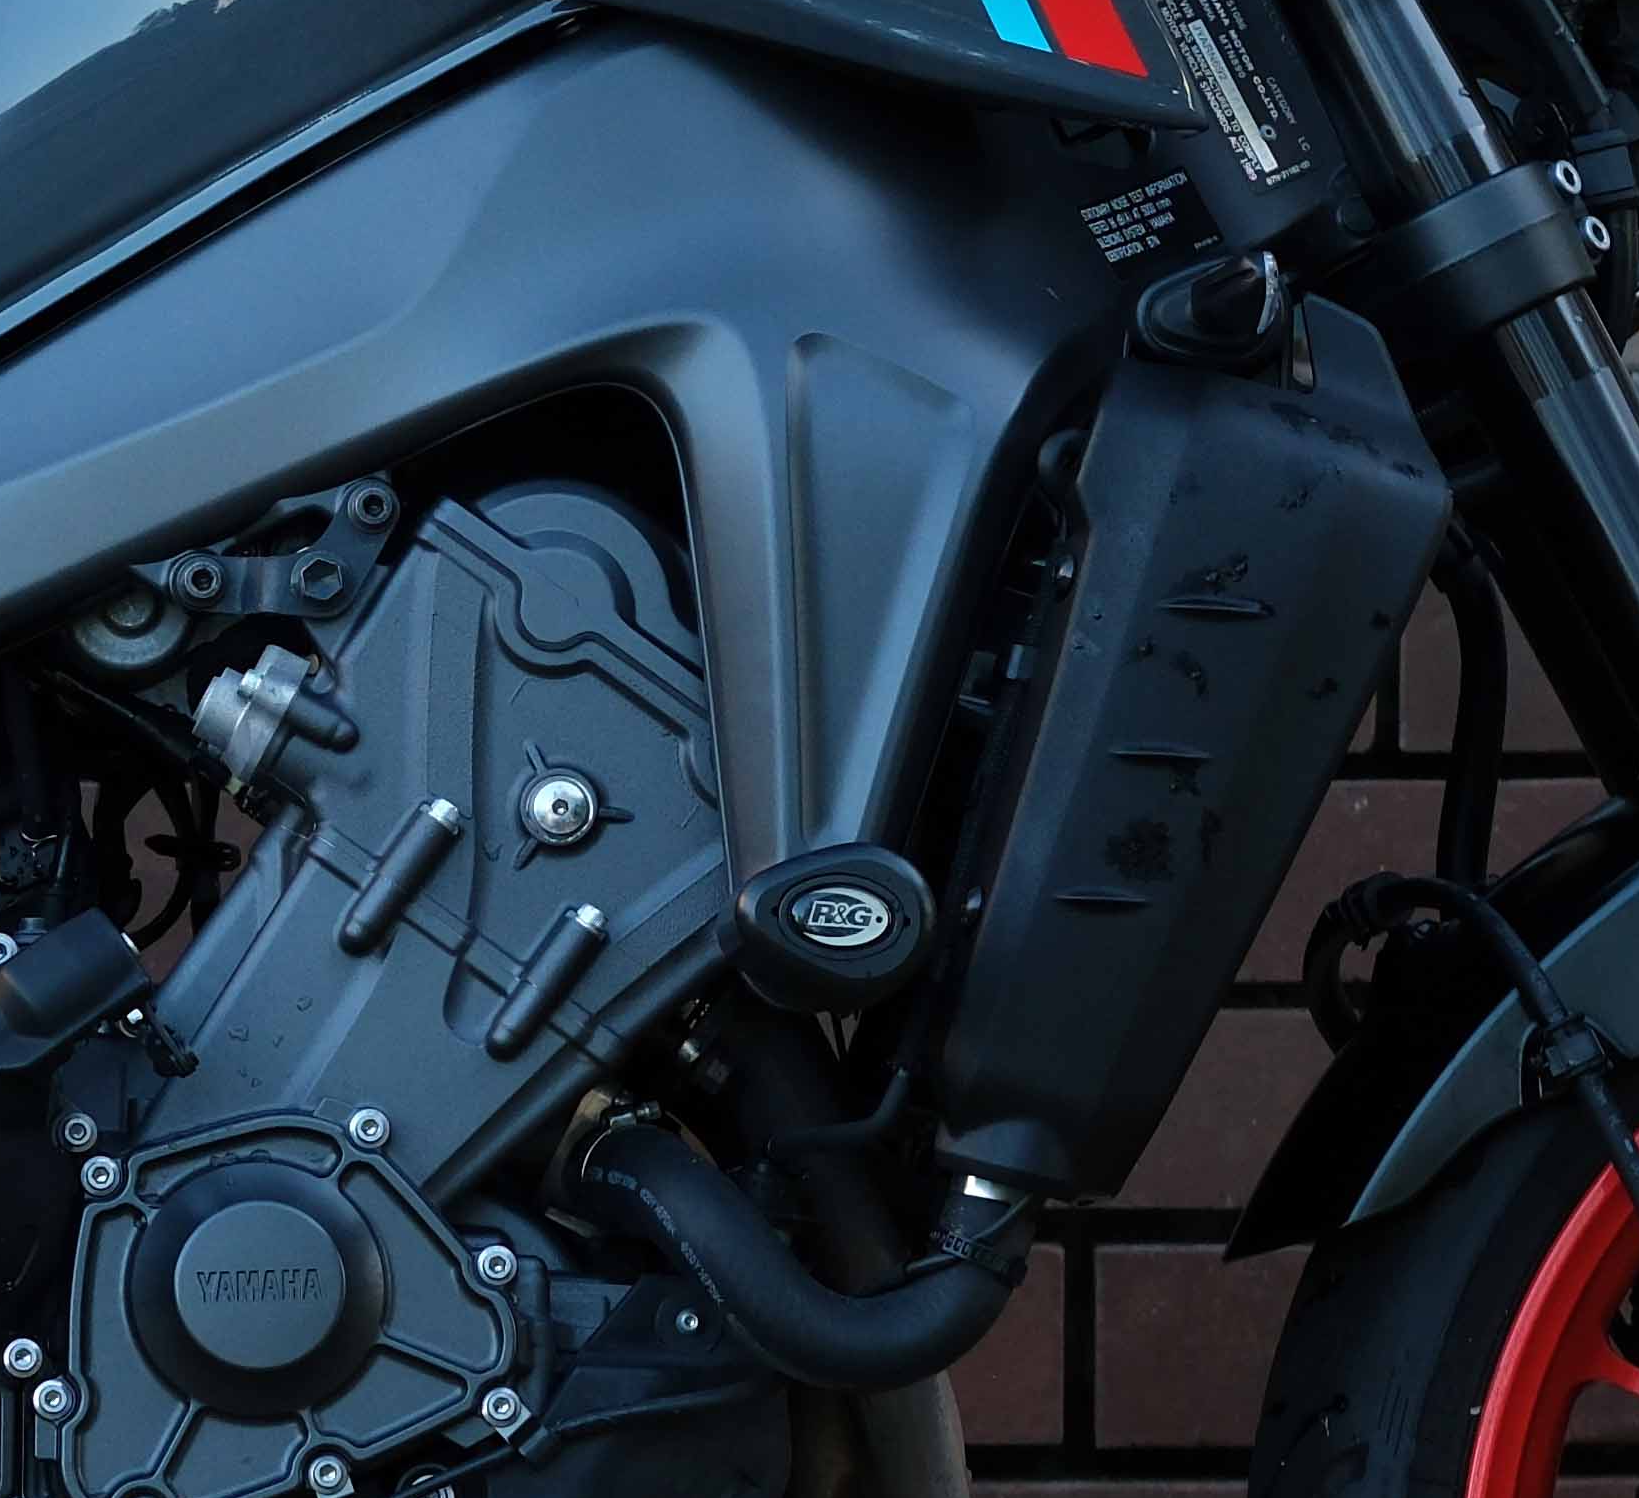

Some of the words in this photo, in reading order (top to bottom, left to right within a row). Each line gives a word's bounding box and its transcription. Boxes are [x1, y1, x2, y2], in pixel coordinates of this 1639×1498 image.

[1227, 28, 1254, 72] MOTOR
[1159, 5, 1182, 39] MOTOR
[1178, 40, 1203, 79] VEHICLE
[1198, 79, 1231, 134] STANDARDS
[1227, 134, 1243, 154] ACT
[1176, 18, 1194, 43] WAS
[1190, 43, 1233, 118] MANUFACTURED
[1237, 133, 1262, 172] COMPLY
[809, 901, 873, 927] R&G
[196, 1268, 325, 1303] YAMAHA
